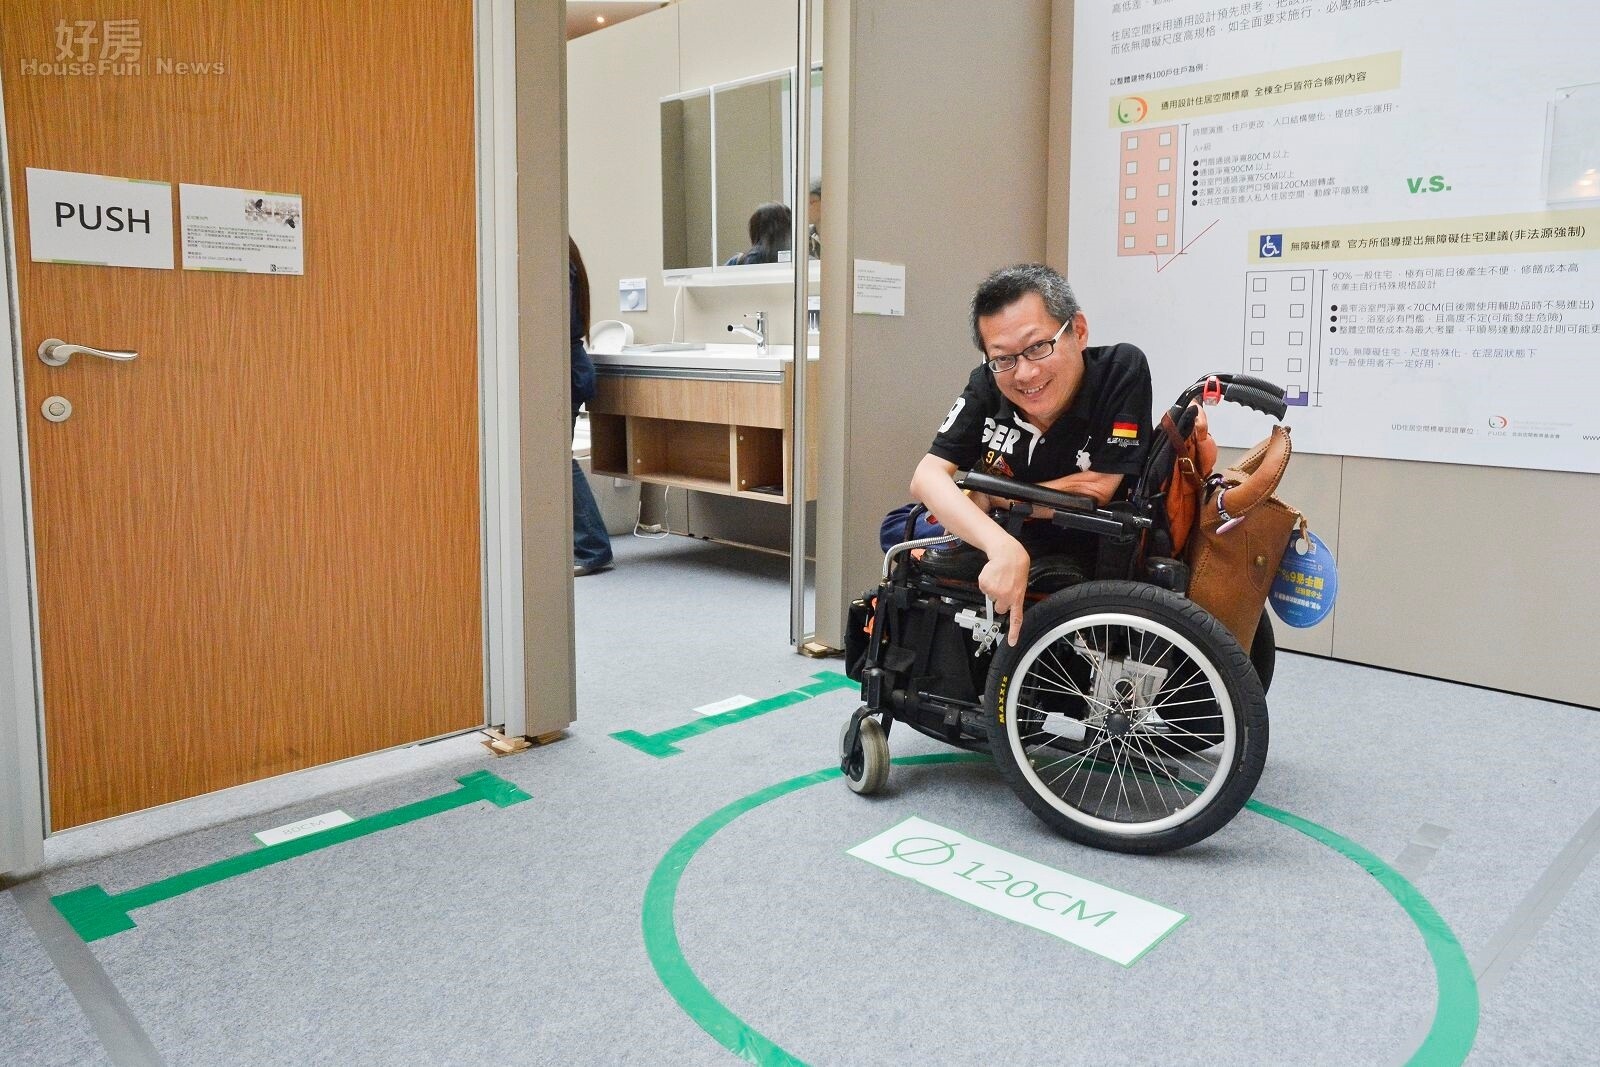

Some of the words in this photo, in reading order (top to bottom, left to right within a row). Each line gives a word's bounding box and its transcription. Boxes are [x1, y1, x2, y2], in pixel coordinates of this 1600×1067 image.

[54, 201, 151, 234] PUSH
[1332, 271, 1353, 281] 90%
[1328, 346, 1349, 357] 10%
[952, 860, 1119, 928] 120CM
